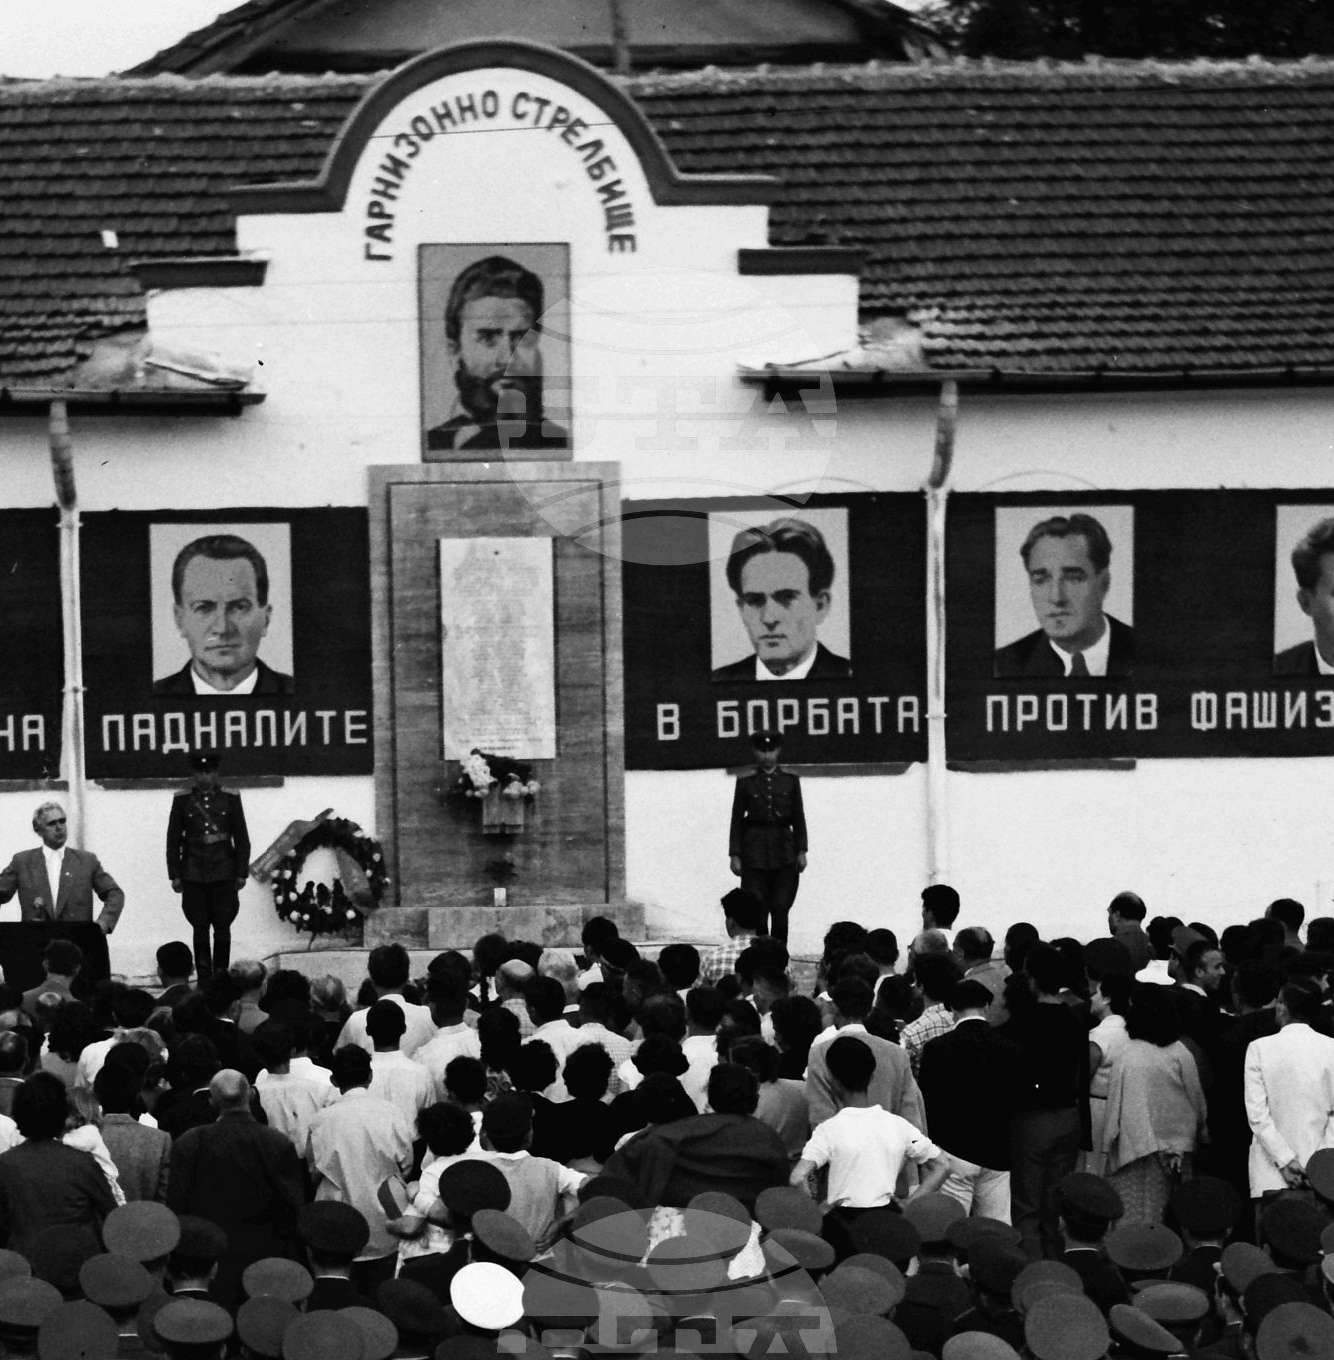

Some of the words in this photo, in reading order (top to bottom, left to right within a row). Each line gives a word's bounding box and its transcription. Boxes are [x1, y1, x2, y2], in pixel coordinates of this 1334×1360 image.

[364, 89, 499, 262] ГАРНИЗОННО
[511, 91, 637, 254] СТРЕЛБИЩЕ
[102, 709, 367, 755] ПАДНАЛИТЕ
[656, 703, 680, 741] В
[716, 695, 919, 738] БОРБАТА
[986, 693, 1158, 732] ПРОТИВ
